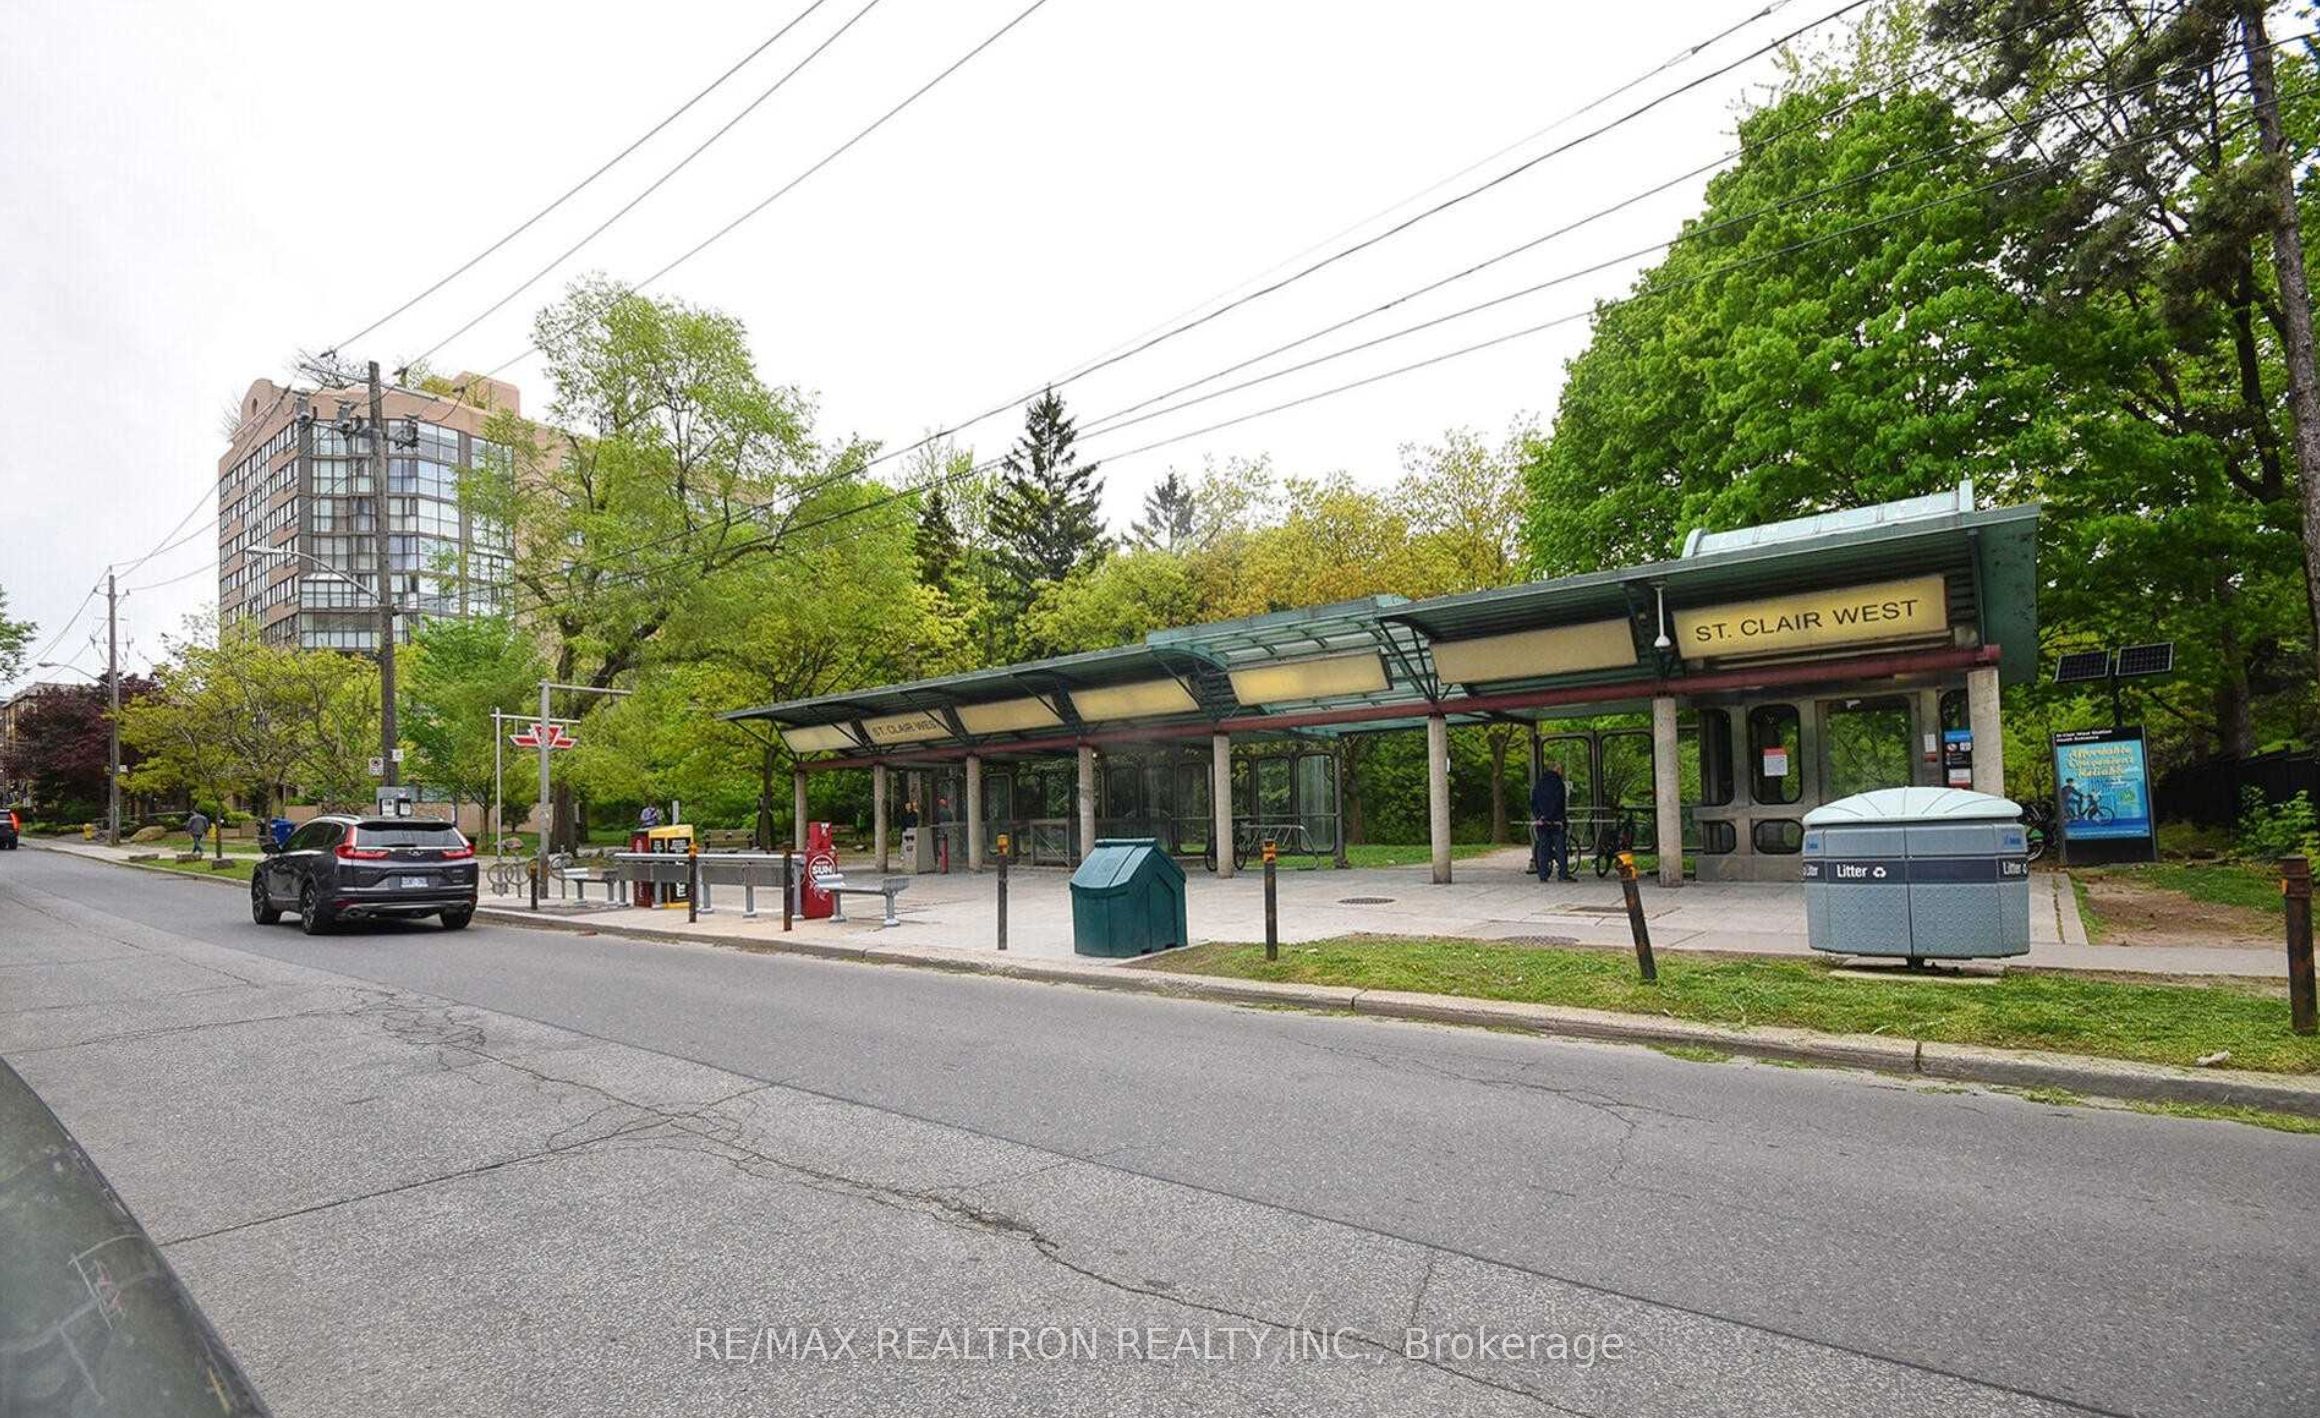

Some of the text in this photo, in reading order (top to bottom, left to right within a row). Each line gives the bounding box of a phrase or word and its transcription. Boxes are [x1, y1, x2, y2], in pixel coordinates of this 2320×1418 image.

[1695, 599, 1919, 642] ST. CLAIR WEST
[872, 726, 888, 737] ST.
[812, 864, 833, 877] SUN
[1836, 864, 1869, 878] Litter
